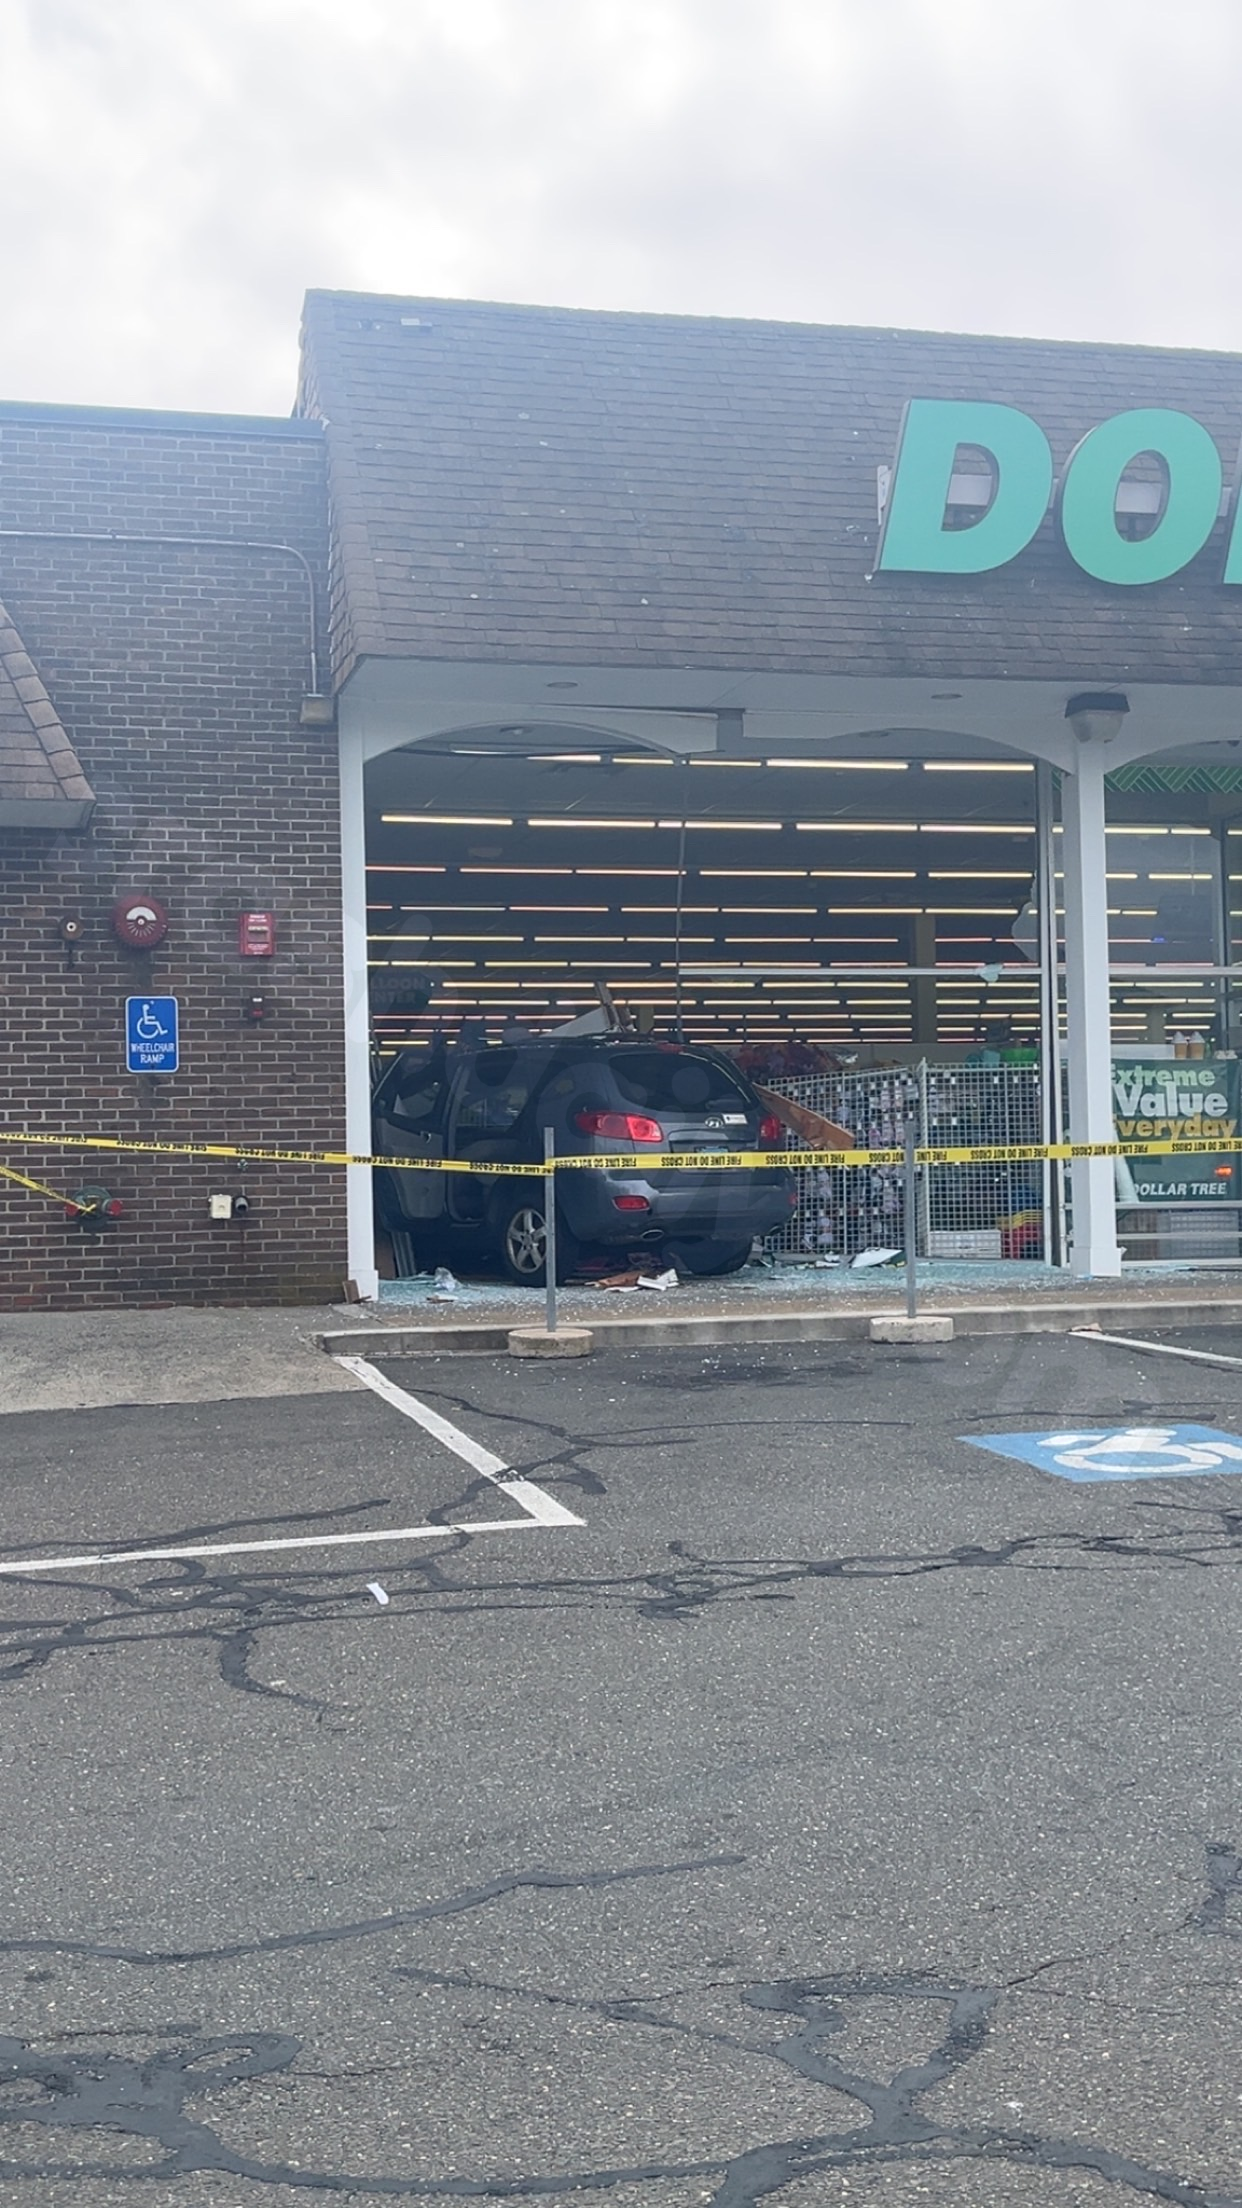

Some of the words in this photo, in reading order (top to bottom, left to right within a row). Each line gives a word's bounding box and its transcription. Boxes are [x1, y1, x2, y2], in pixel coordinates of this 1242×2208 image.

[876, 397, 1242, 586] DO
[131, 1043, 175, 1053] WHEELCHAIR
[140, 1054, 165, 1064] RAMP
[1113, 1081, 1228, 1117] Value
[1113, 1113, 1238, 1142] veryday
[1071, 1146, 1092, 1156] CROSS
[1094, 1145, 1106, 1156] NOT
[1108, 1145, 1117, 1155] DO
[1119, 1144, 1133, 1154] LINE
[1134, 1144, 1148, 1153] FIRE
[1171, 1142, 1193, 1153] CROSS
[1194, 1142, 1206, 1152] NOT
[1208, 1141, 1217, 1151] DO
[1218, 1141, 1232, 1151] LINE
[868, 1152, 891, 1163] CROSS
[892, 1152, 904, 1163] NOT
[916, 1151, 931, 1162] LINE
[933, 1150, 948, 1161] FIRE
[970, 1149, 993, 1160] CROSS
[994, 1149, 1006, 1159] NOT
[1008, 1148, 1017, 1159] DO
[1018, 1148, 1032, 1158] LINE
[1033, 1147, 1048, 1158] FIRE
[661, 1156, 683, 1167] CROSS
[685, 1156, 698, 1166] NOT
[700, 1156, 709, 1166] DO
[710, 1156, 725, 1166] LINE
[727, 1155, 742, 1166] FIRE
[765, 1154, 788, 1165] CROSS
[789, 1155, 802, 1165] NOT
[804, 1154, 813, 1165] DO
[814, 1154, 829, 1164] LINE
[831, 1154, 845, 1164] FIRE
[1191, 1181, 1227, 1195] TREE
